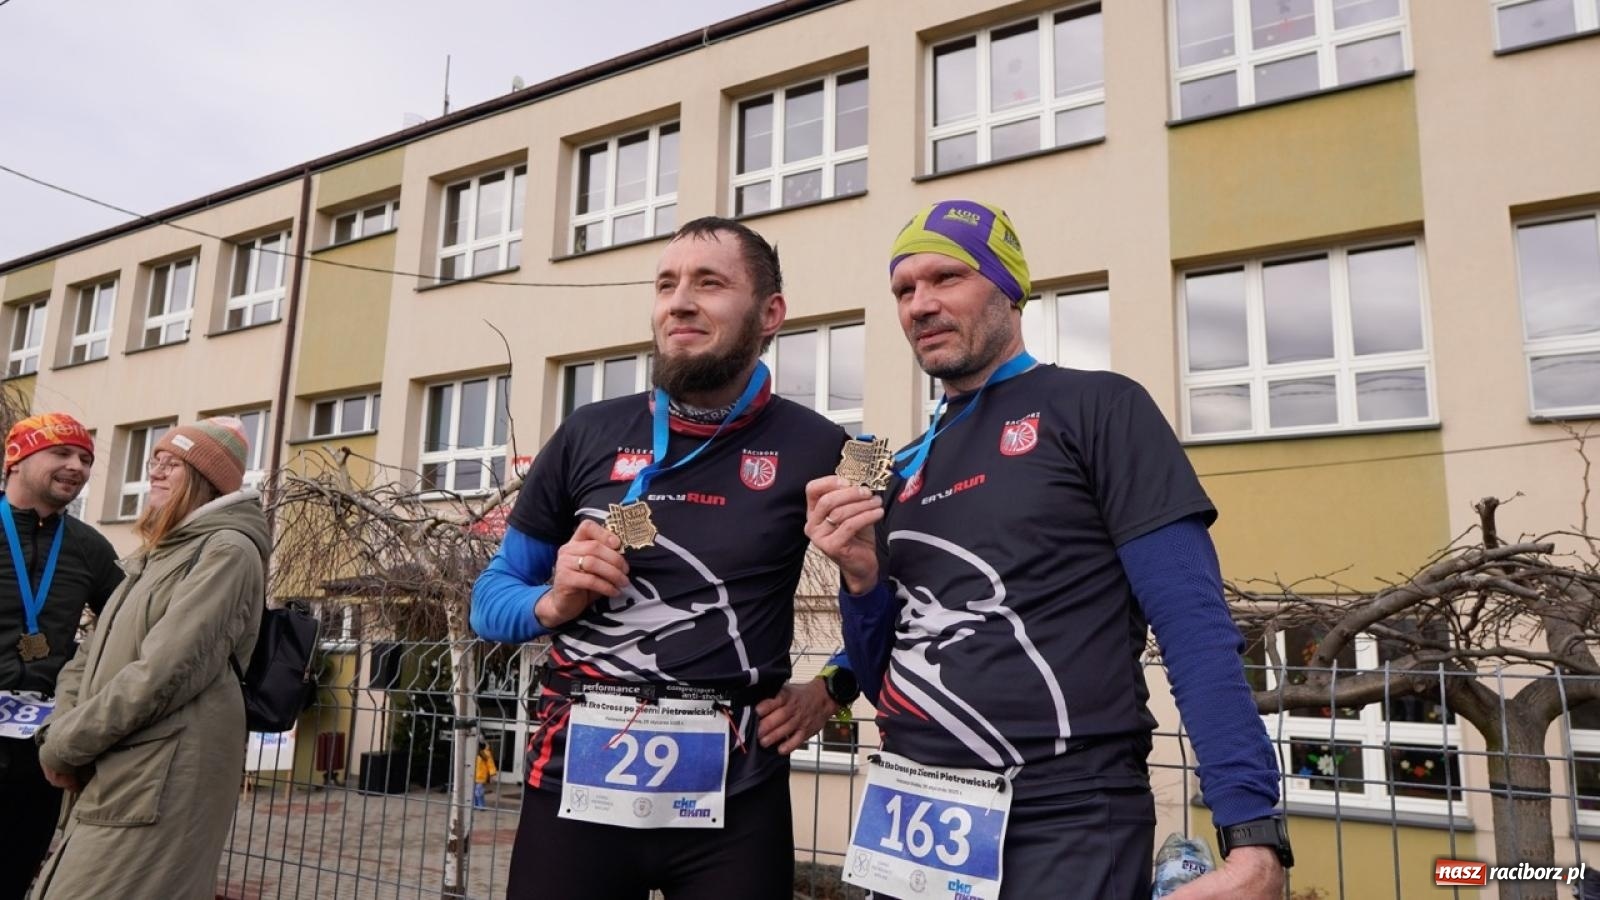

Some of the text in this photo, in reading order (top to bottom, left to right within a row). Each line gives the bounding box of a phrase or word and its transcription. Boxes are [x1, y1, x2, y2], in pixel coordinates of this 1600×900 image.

[583, 683, 640, 693] performance
[601, 703, 622, 711] Cross
[624, 705, 634, 714] po
[605, 733, 679, 787] 29
[940, 772, 999, 790] Pietrowickie
[880, 795, 972, 867] 163
